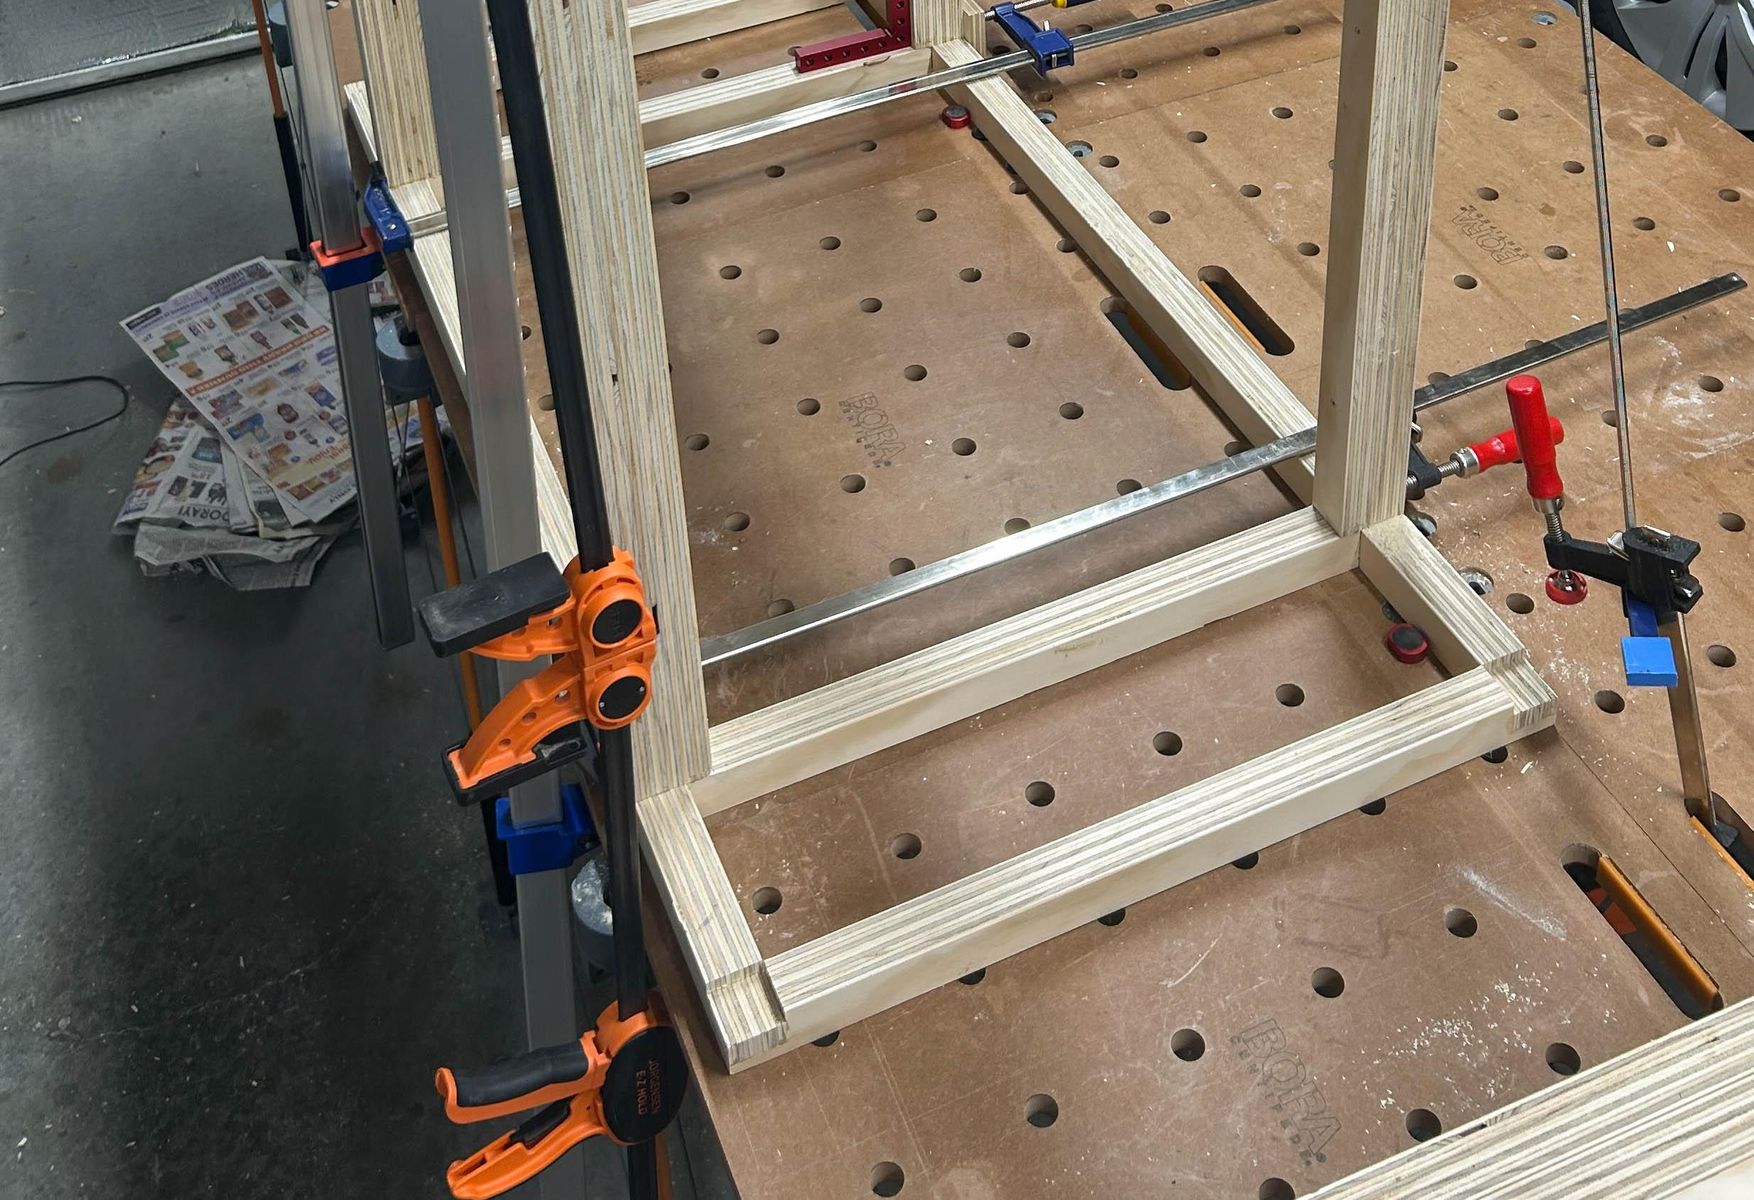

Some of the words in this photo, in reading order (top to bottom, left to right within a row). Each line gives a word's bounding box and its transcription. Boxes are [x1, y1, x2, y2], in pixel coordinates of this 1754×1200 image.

[1452, 209, 1524, 266] BORA
[844, 391, 907, 461] BORA
[637, 1088, 648, 1115] HOLD
[1240, 1018, 1342, 1156] BORA
